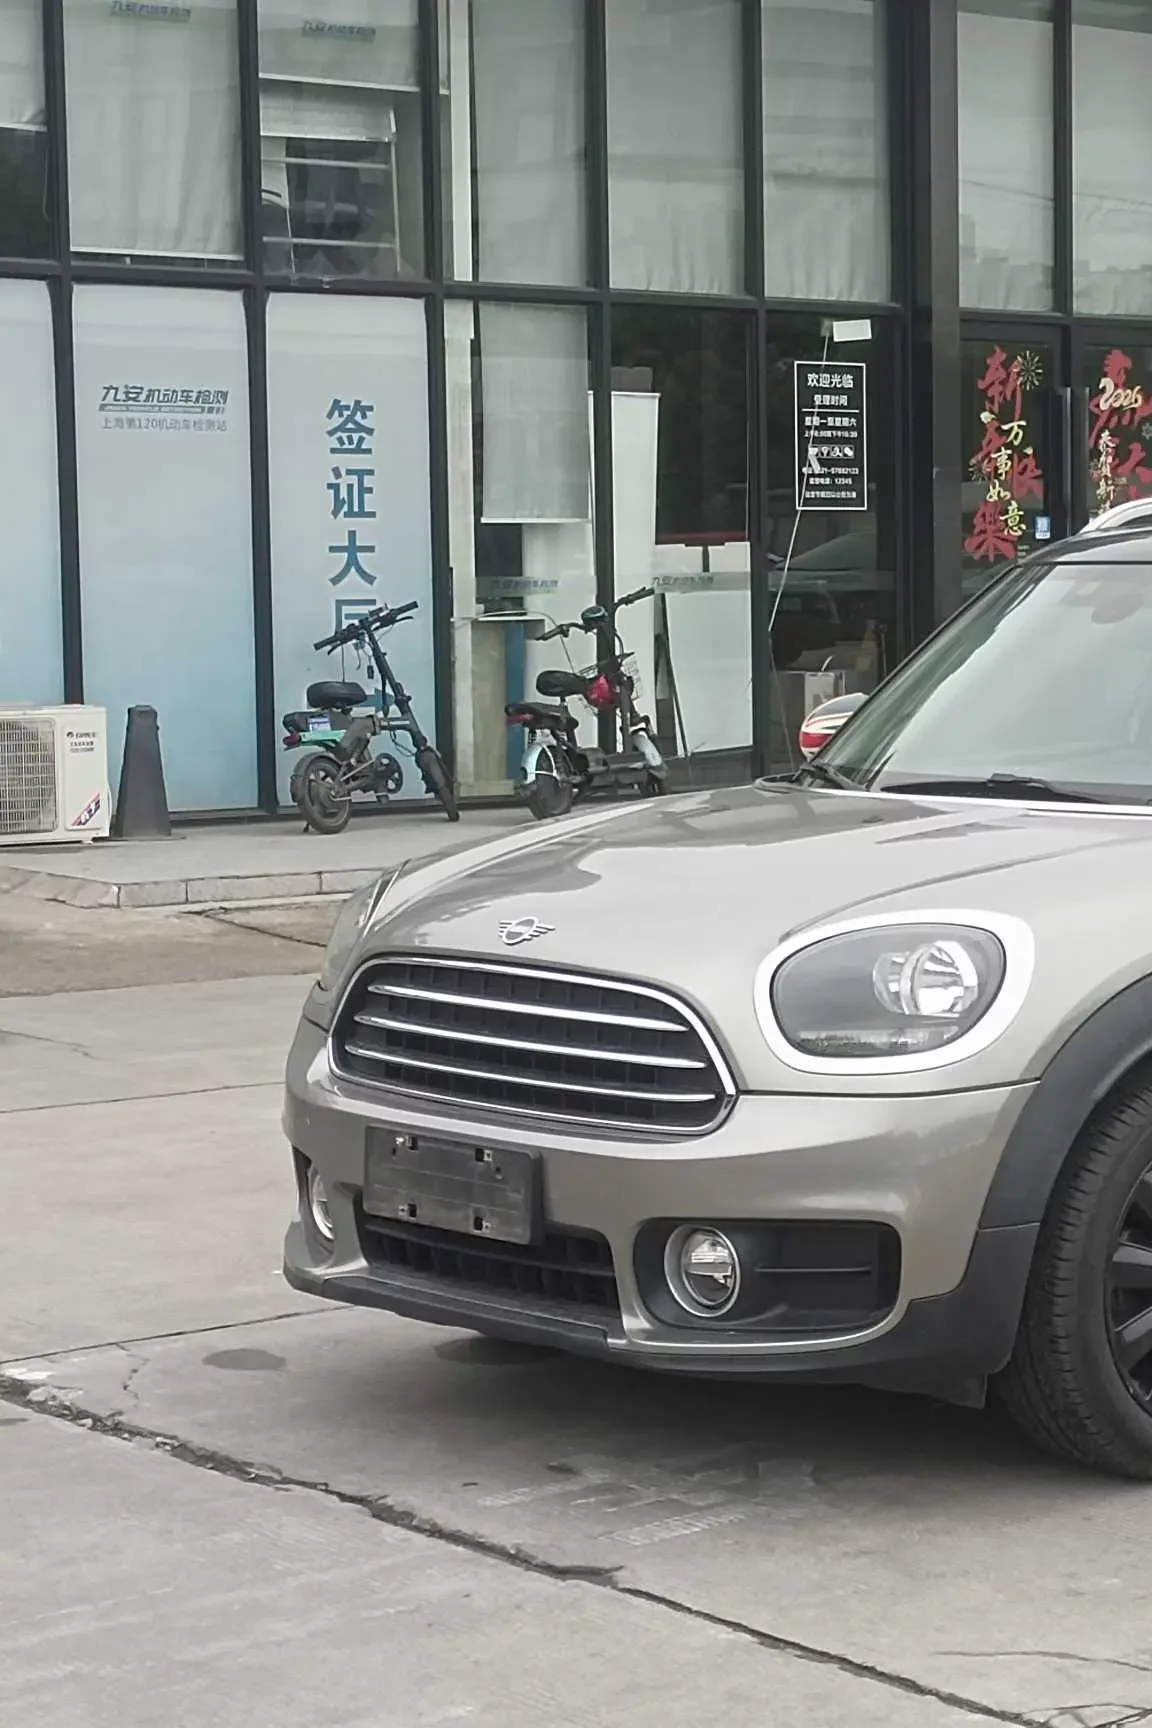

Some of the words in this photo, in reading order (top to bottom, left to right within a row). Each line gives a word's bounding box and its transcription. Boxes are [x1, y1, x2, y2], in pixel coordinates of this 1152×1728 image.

[807, 373, 854, 388] 欢迎光临
[1099, 377, 1143, 411] 2026
[100, 384, 229, 405] 九安机动车检测
[985, 420, 1027, 537] 万事如意
